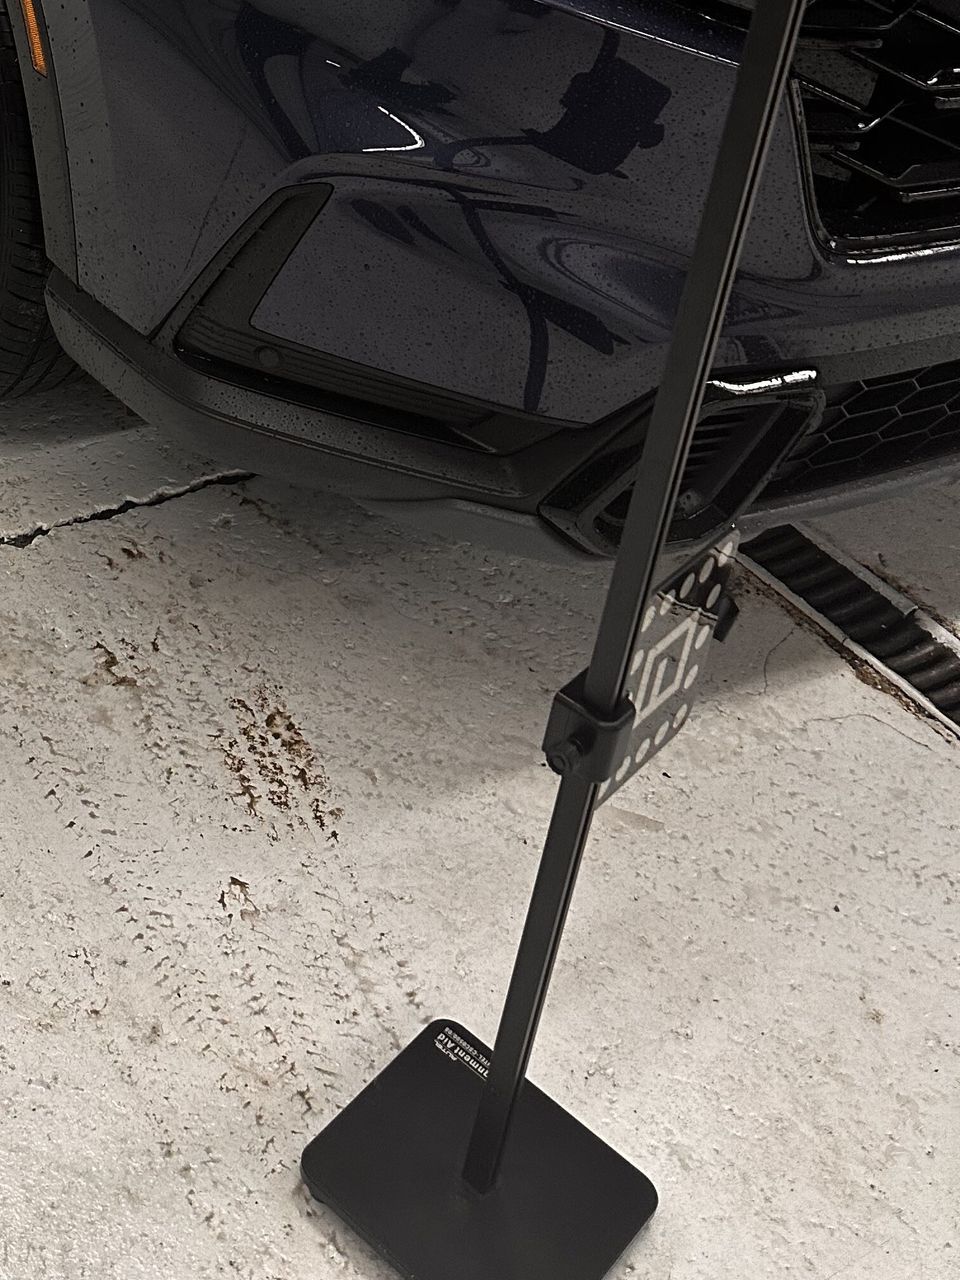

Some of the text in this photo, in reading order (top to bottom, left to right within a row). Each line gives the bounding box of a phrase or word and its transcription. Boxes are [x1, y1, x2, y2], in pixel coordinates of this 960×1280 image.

[434, 1039, 457, 1061] AUTEL
[436, 1033, 489, 1078] nment Aid
